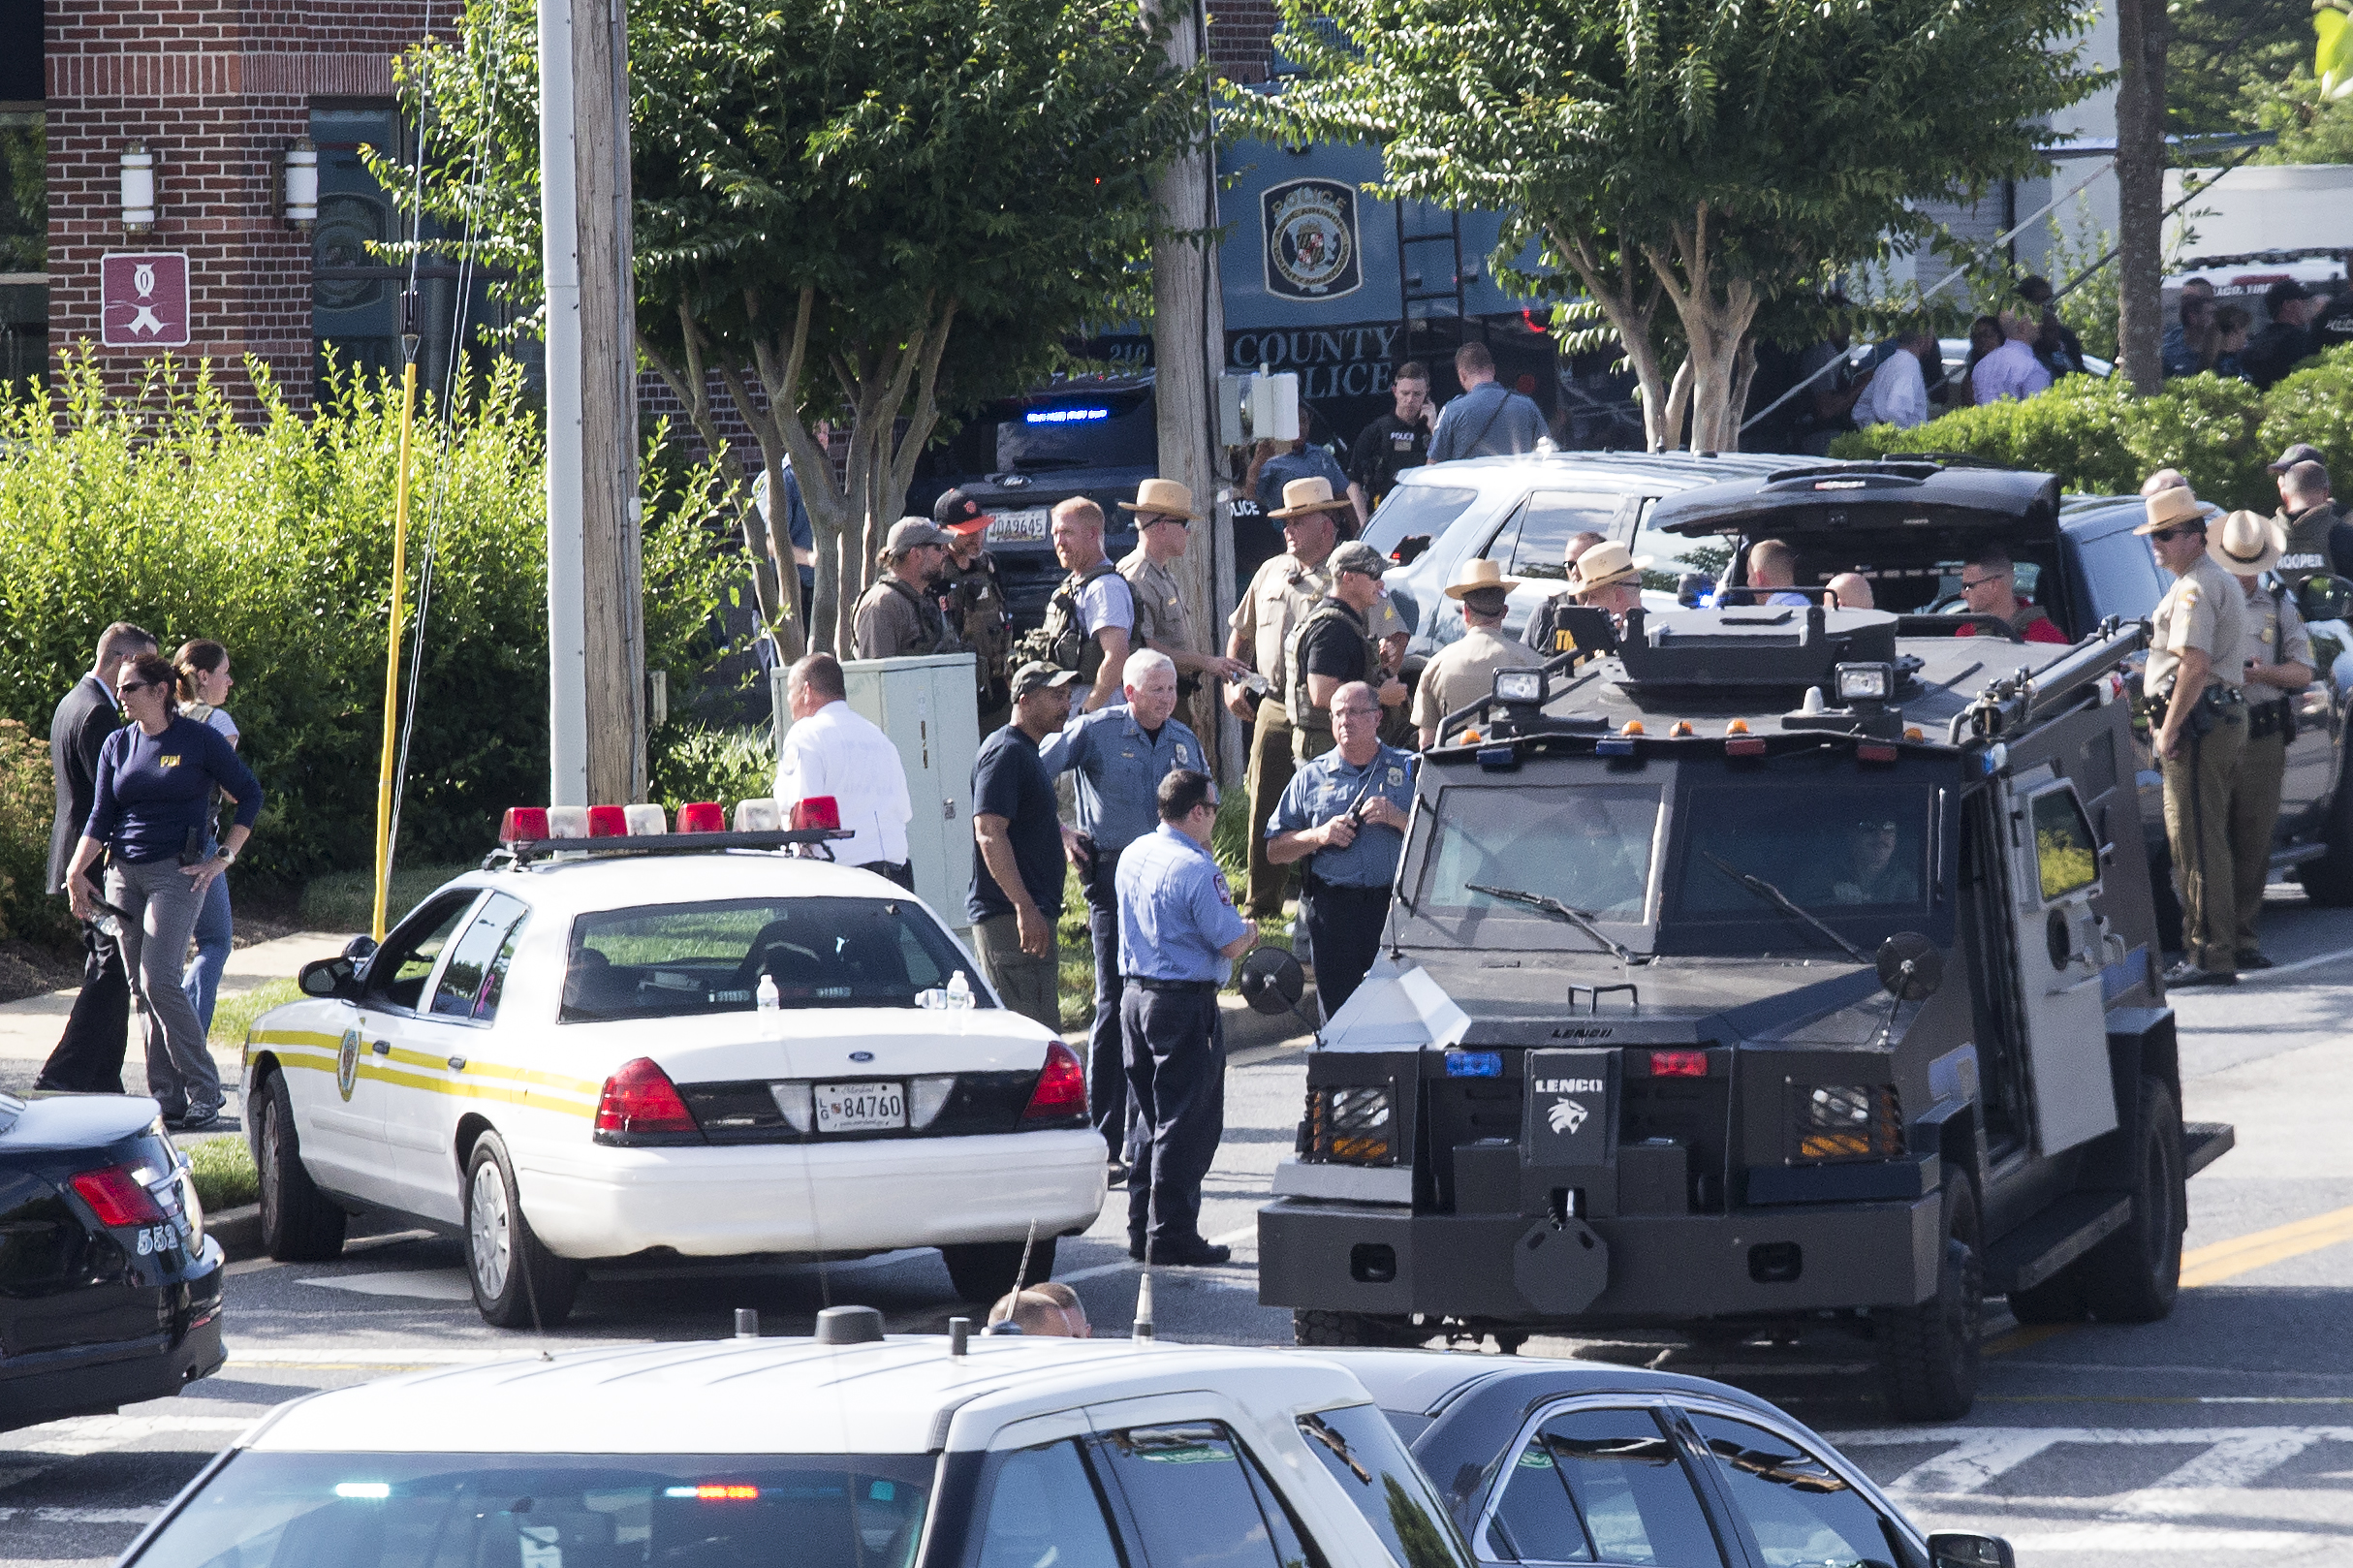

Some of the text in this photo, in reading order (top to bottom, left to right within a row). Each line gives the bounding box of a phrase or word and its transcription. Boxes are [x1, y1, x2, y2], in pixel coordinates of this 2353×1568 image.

[1271, 187, 1347, 214] POLICE
[1233, 327, 1397, 366] COUNTY
[1303, 362, 1393, 398] LICE
[1231, 500, 1260, 517] LICE
[2276, 553, 2325, 570] ROOPER
[1535, 1079, 1603, 1093] LENCO
[844, 1095, 901, 1118] 84760
